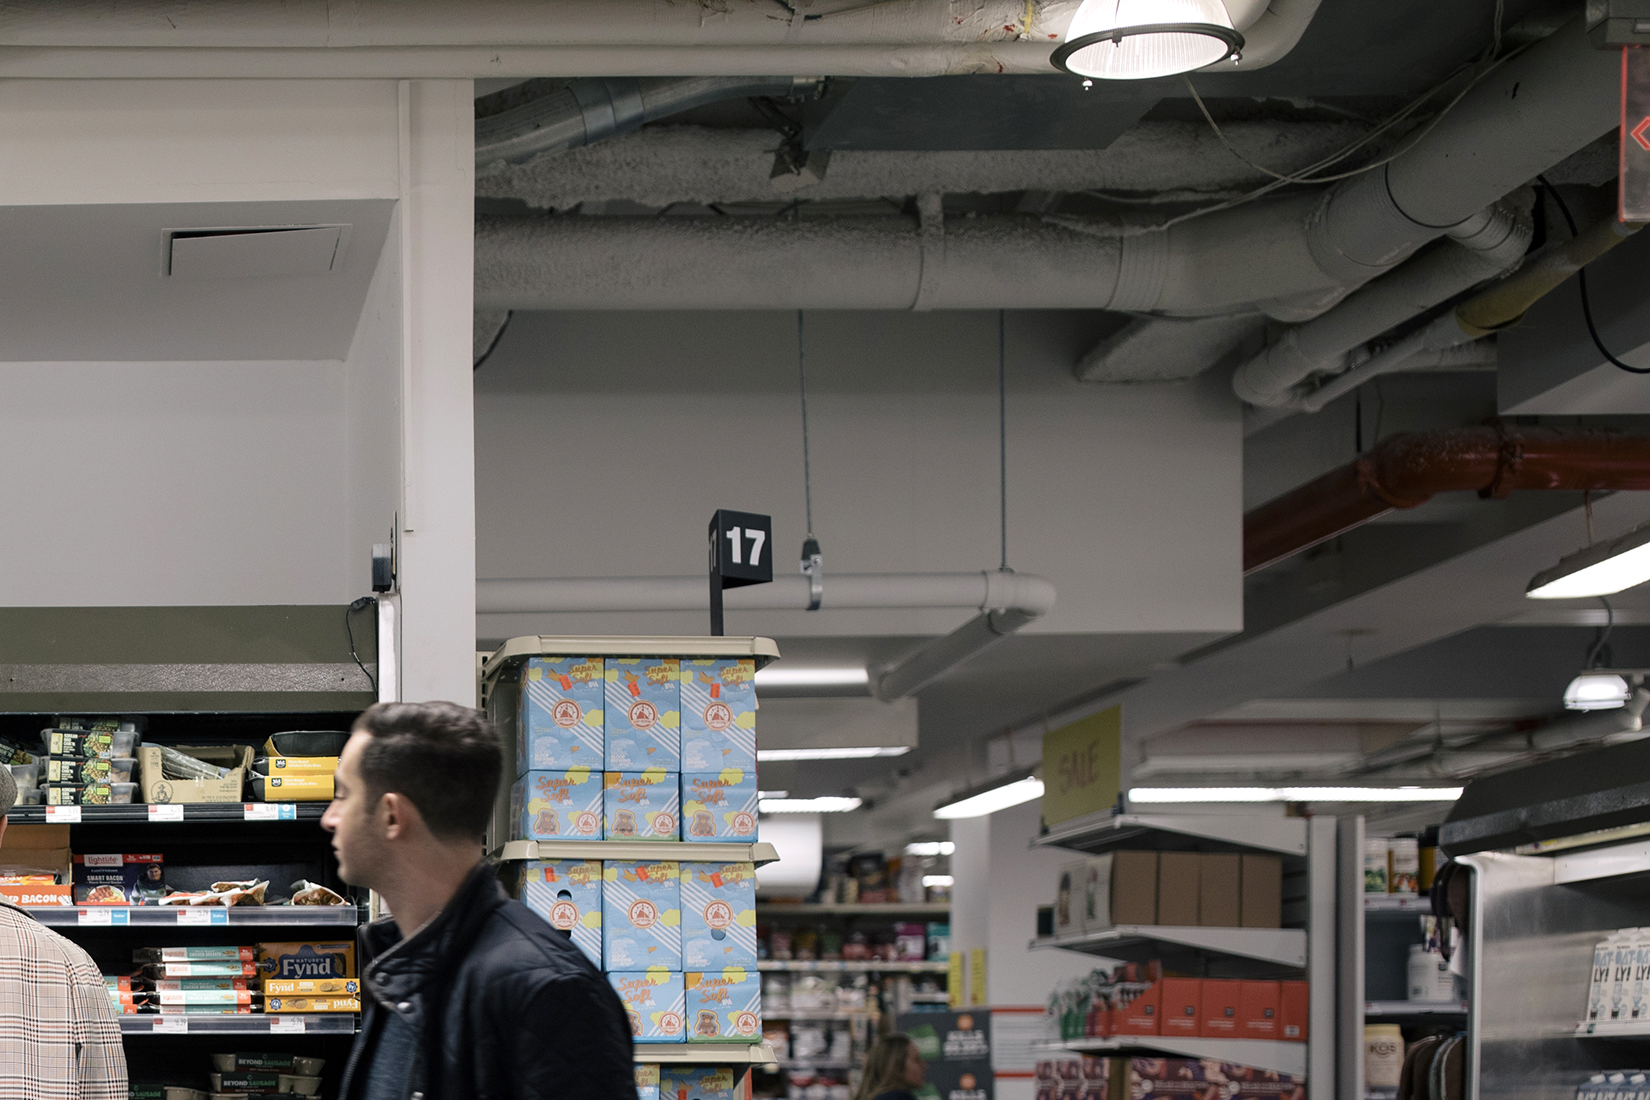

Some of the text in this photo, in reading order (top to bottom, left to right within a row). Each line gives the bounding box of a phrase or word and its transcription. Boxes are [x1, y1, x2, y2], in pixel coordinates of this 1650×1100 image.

[726, 526, 766, 566] 17
[1059, 739, 1100, 796] SALE
[536, 776, 577, 790] Super
[690, 777, 732, 792] Super
[540, 788, 570, 803] Soft
[695, 790, 725, 804] Soft
[87, 856, 118, 865] lightlife
[21, 894, 57, 903] BACON
[283, 958, 331, 978] Fynd
[1615, 966, 1632, 981] LY!
[269, 982, 294, 993] Fynd
[617, 977, 658, 991] Super
[696, 977, 735, 990] Super
[622, 989, 652, 1003] Soft
[700, 989, 729, 1003] Soft
[264, 1059, 291, 1067] SAUSAGE
[249, 1079, 276, 1087] SAUSAGE
